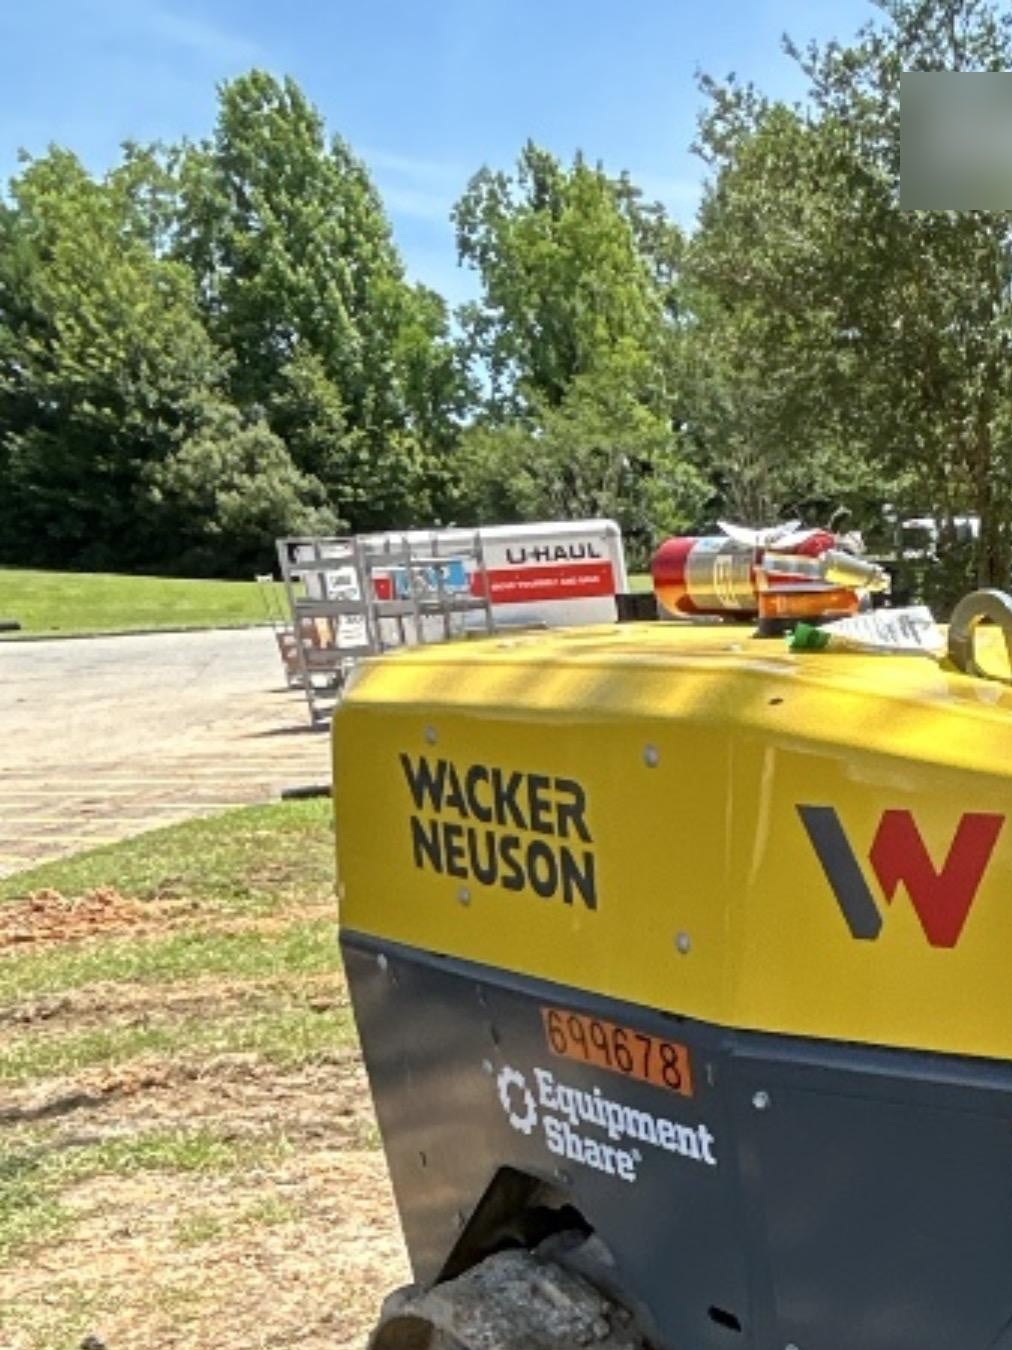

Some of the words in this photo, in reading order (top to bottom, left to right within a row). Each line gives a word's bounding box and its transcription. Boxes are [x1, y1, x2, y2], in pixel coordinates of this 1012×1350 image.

[400, 753, 594, 843] WACKER
[411, 815, 598, 911] NEUSON
[547, 1009, 682, 1090] 699678
[533, 1066, 718, 1166] Equipment
